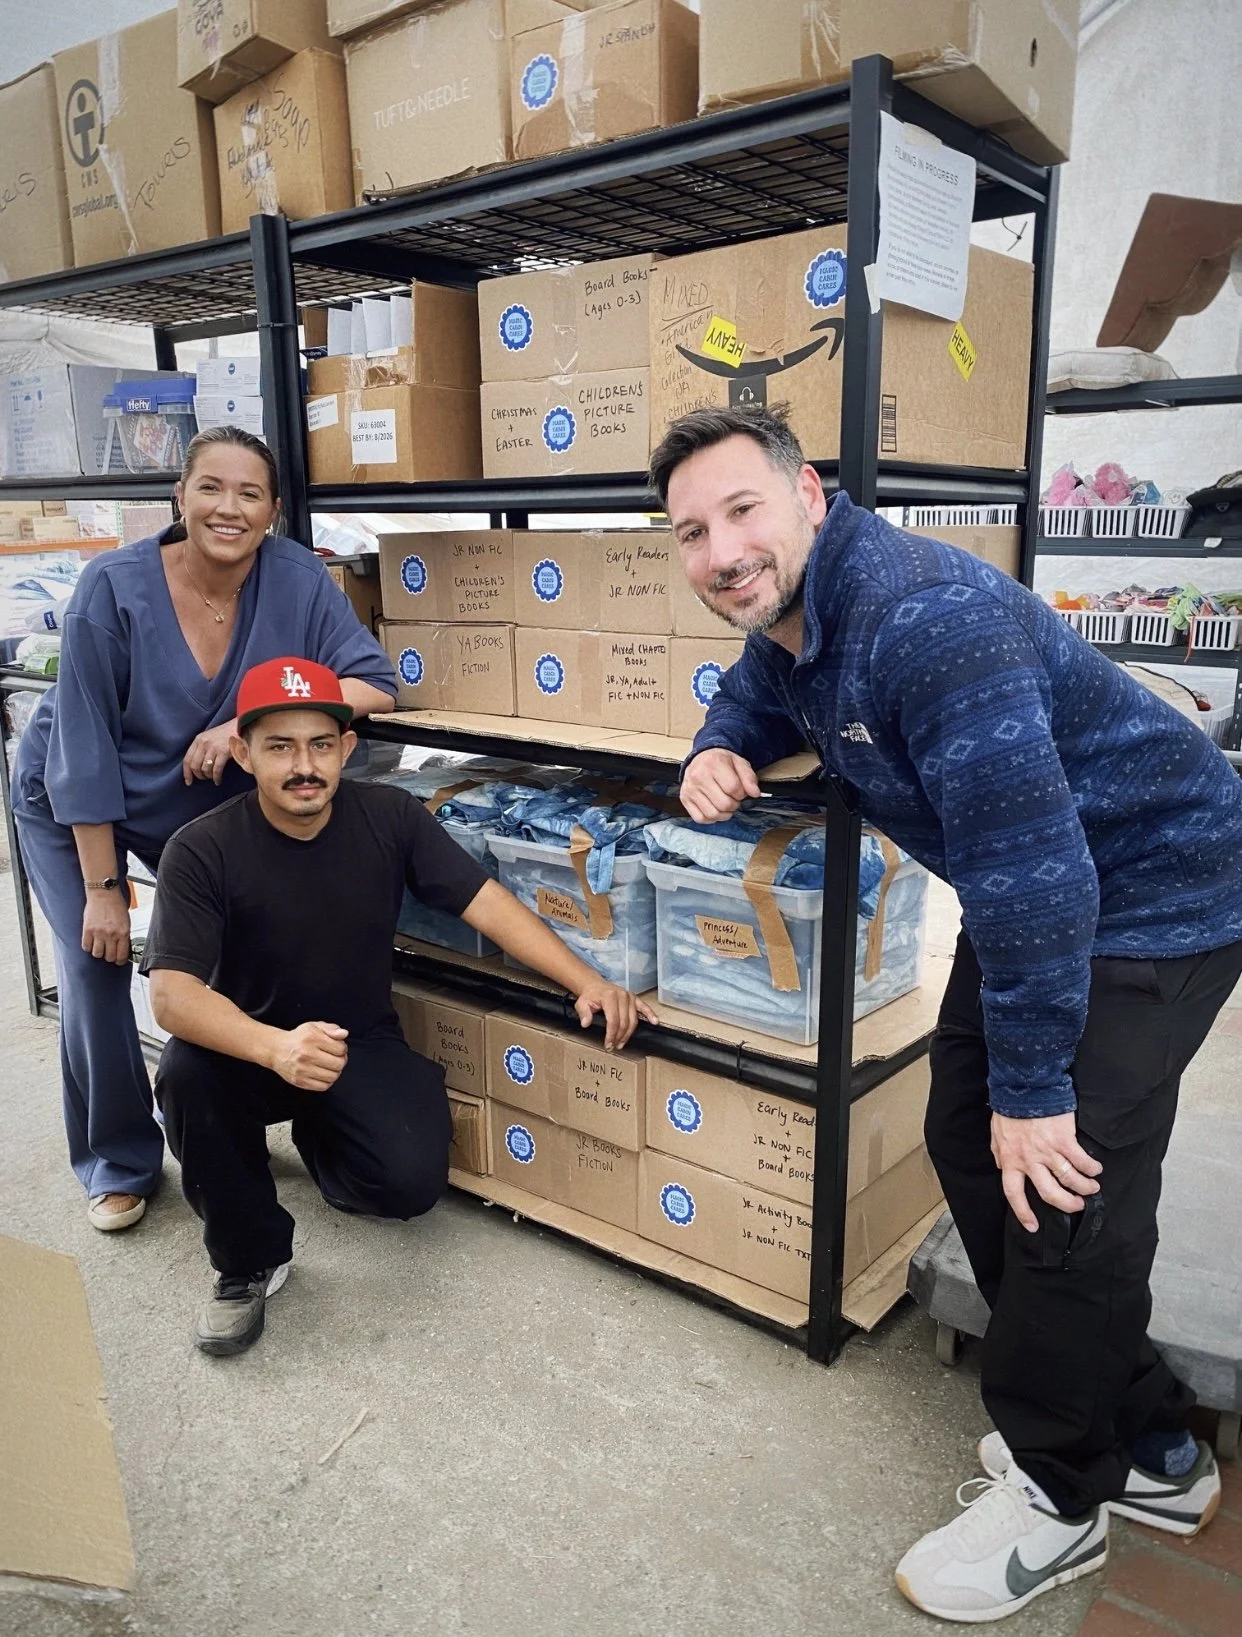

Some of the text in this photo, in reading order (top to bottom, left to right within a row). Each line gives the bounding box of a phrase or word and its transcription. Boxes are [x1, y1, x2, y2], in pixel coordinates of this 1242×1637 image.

[373, 77, 471, 131] TUFT&NEEDLE
[894, 145, 959, 187] FILMING IN PROGRESS
[585, 269, 649, 296] Board Books
[818, 281, 837, 290] CARES
[663, 276, 709, 308] MIXED
[584, 290, 642, 320] (Ages 0-3)
[706, 327, 746, 358] HEAVY
[951, 329, 974, 370] HEAVY
[128, 400, 150, 410] Hefty
[584, 403, 635, 421] PICTURE
[491, 407, 538, 420] CHRISTMAS
[358, 422, 370, 430] SKU:
[352, 432, 394, 442] BEST BY: 8/2026
[495, 438, 533, 452] EASTER
[452, 544, 503, 557] JR NON FIC
[606, 545, 669, 572] Early Readers
[454, 576, 505, 587] CHILDREN'S
[465, 589, 500, 599] PICTURE
[609, 583, 667, 598] JR NON FIC
[458, 601, 490, 613] BOOKS
[457, 634, 504, 655] YA BOOKS
[611, 642, 635, 656] Mixed
[462, 661, 490, 677] FICTION
[283, 666, 311, 698] LA
[633, 676, 657, 686] Adult
[608, 691, 623, 702] FIC
[653, 691, 665, 701] FIC
[552, 907, 578, 922] Animals
[712, 935, 748, 949] Adventure
[436, 1021, 464, 1039] Board
[441, 1038, 469, 1054] Books
[457, 1060, 475, 1076] 0-3)
[577, 1057, 623, 1081] JR NON FIC
[575, 1086, 631, 1112] Board Books
[757, 1101, 816, 1127] Early Read
[576, 1134, 622, 1158] JR BOOKS
[754, 1133, 813, 1160] JR NON FIC
[578, 1153, 613, 1172] FICTION
[758, 1159, 783, 1174] Board
[743, 1197, 754, 1209] JR
[757, 1204, 793, 1228] Activity
[742, 1228, 753, 1240] JR
[756, 1235, 775, 1246] NON
[778, 1241, 791, 1252] FIC
[1022, 1485, 1037, 1499] NIKE
